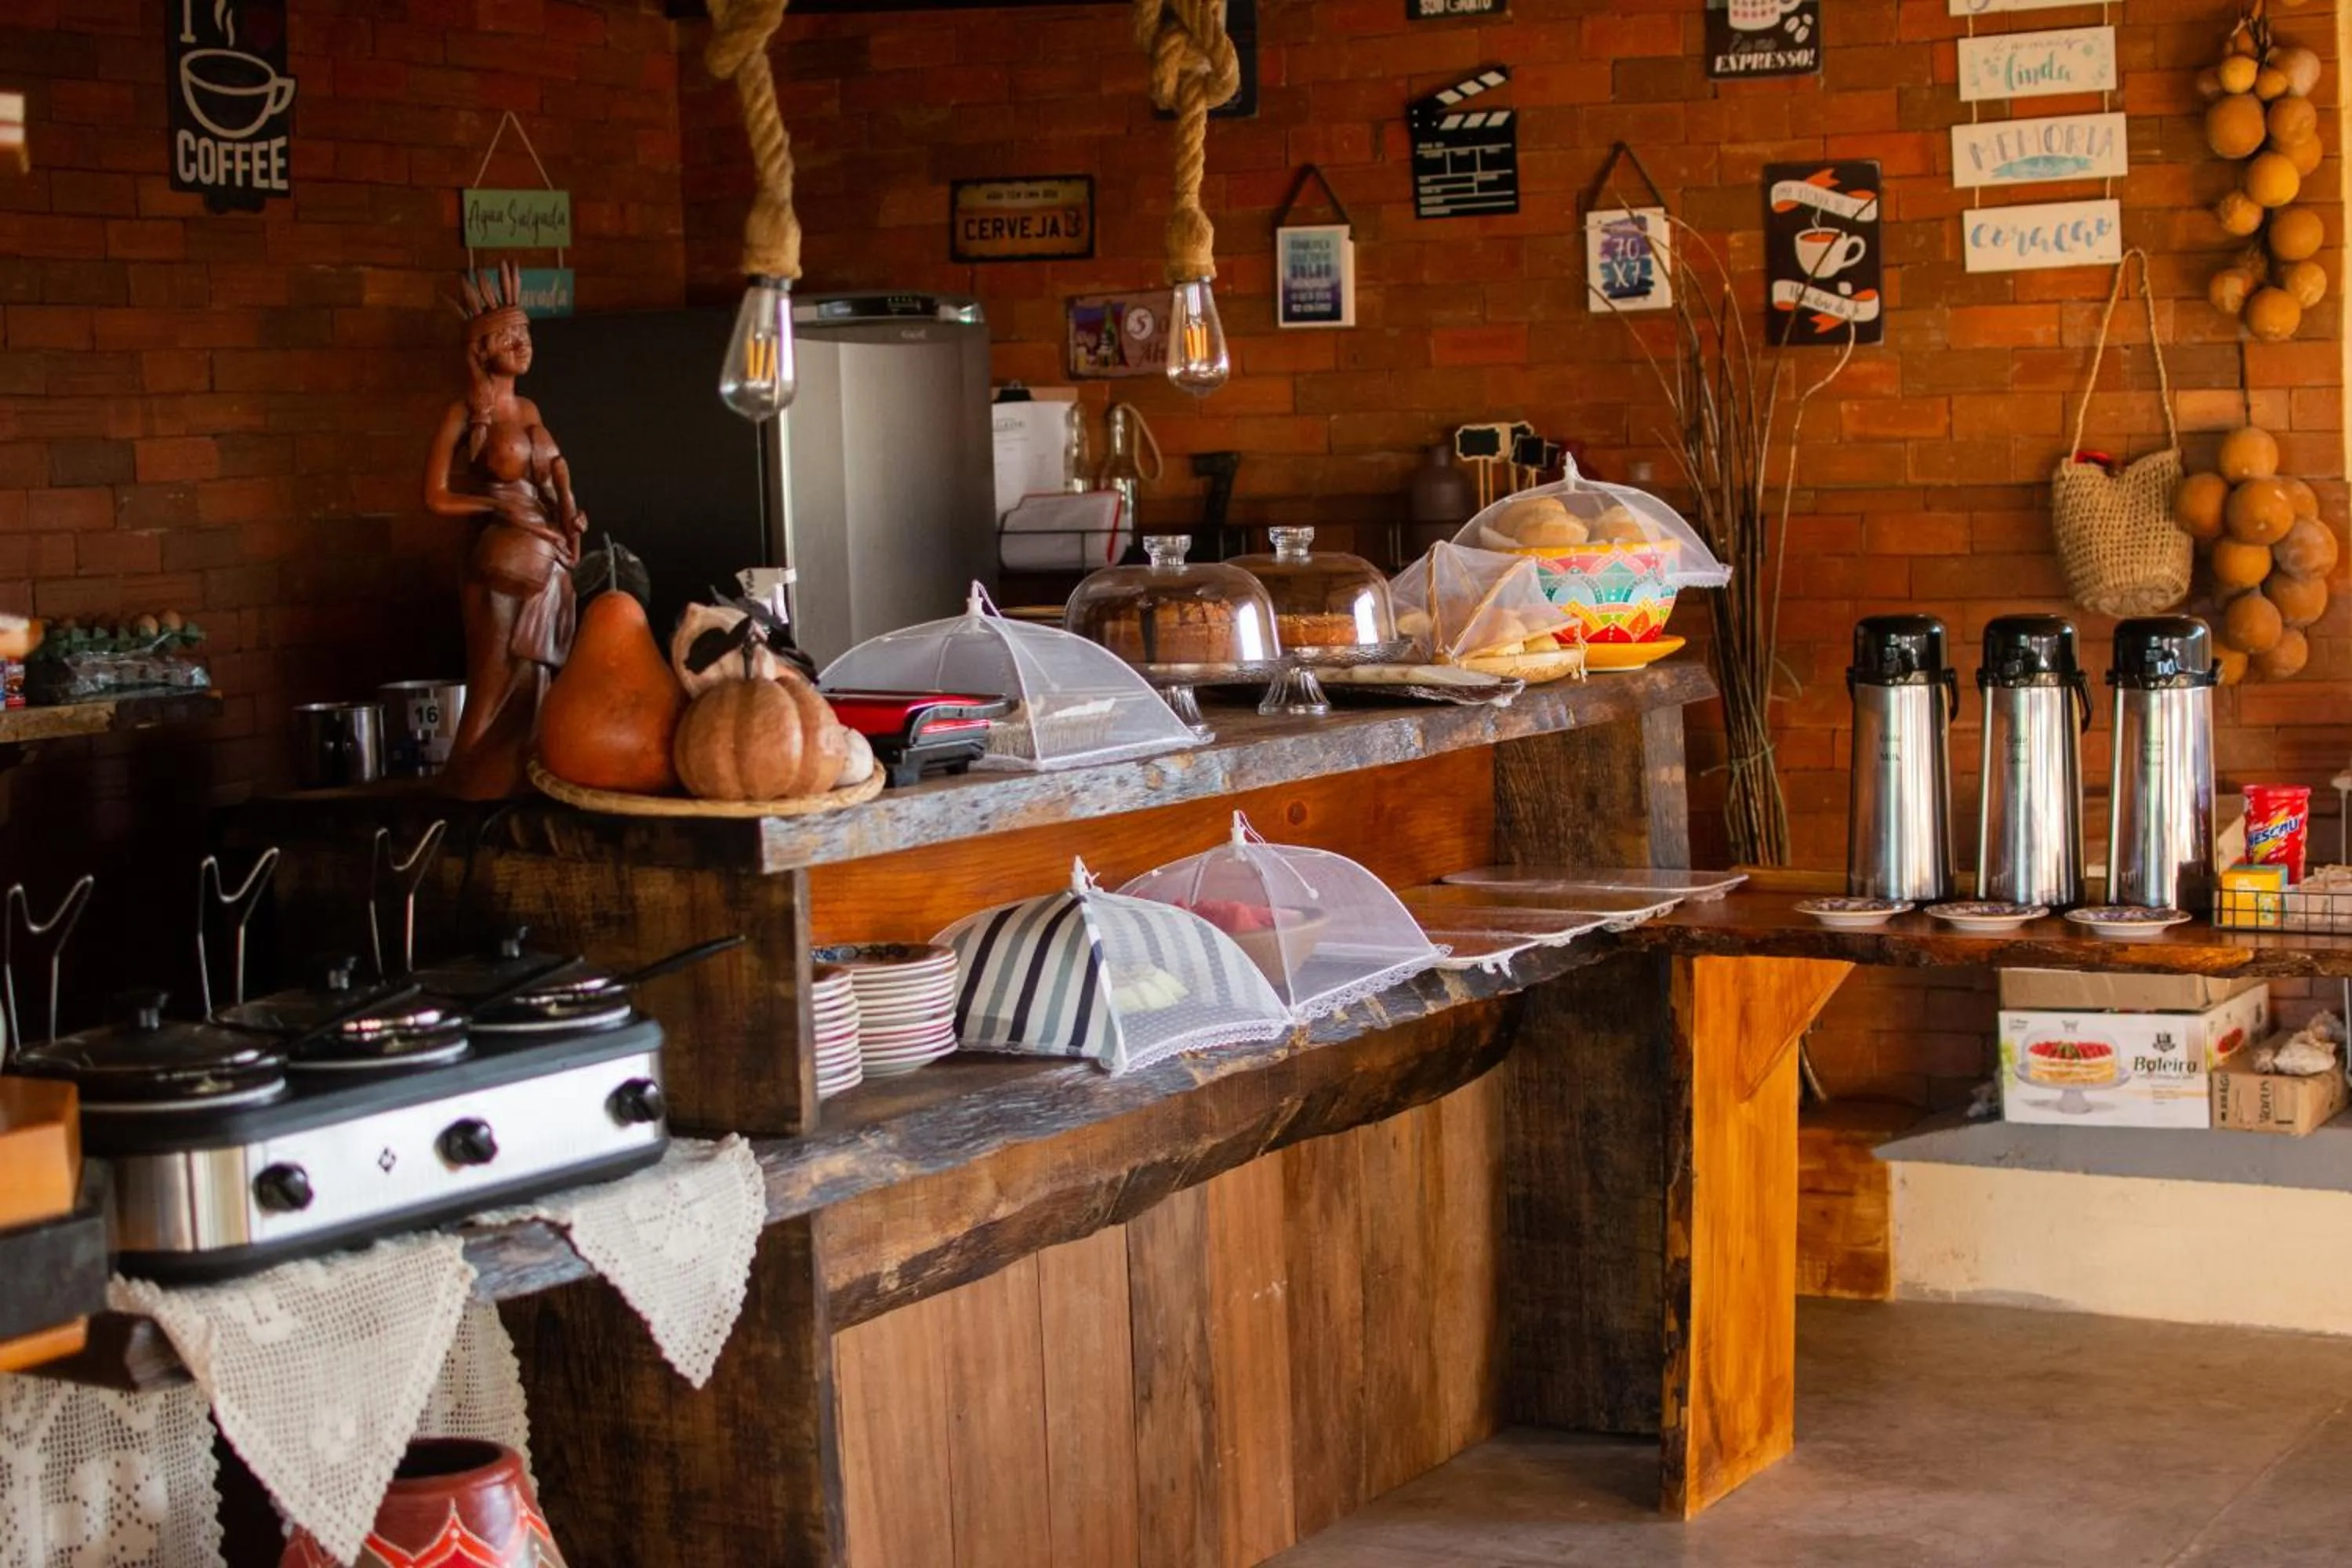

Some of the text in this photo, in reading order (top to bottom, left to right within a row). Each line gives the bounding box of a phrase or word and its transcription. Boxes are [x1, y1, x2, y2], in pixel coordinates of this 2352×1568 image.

[1714, 48, 1816, 73] EXPRESSO!
[176, 128, 289, 191] COFFEE
[964, 216, 1062, 241] CERVEJA
[414, 706, 439, 724] 16
[2248, 818, 2299, 846] NESCAU
[2133, 1055, 2198, 1073] Boleiro
